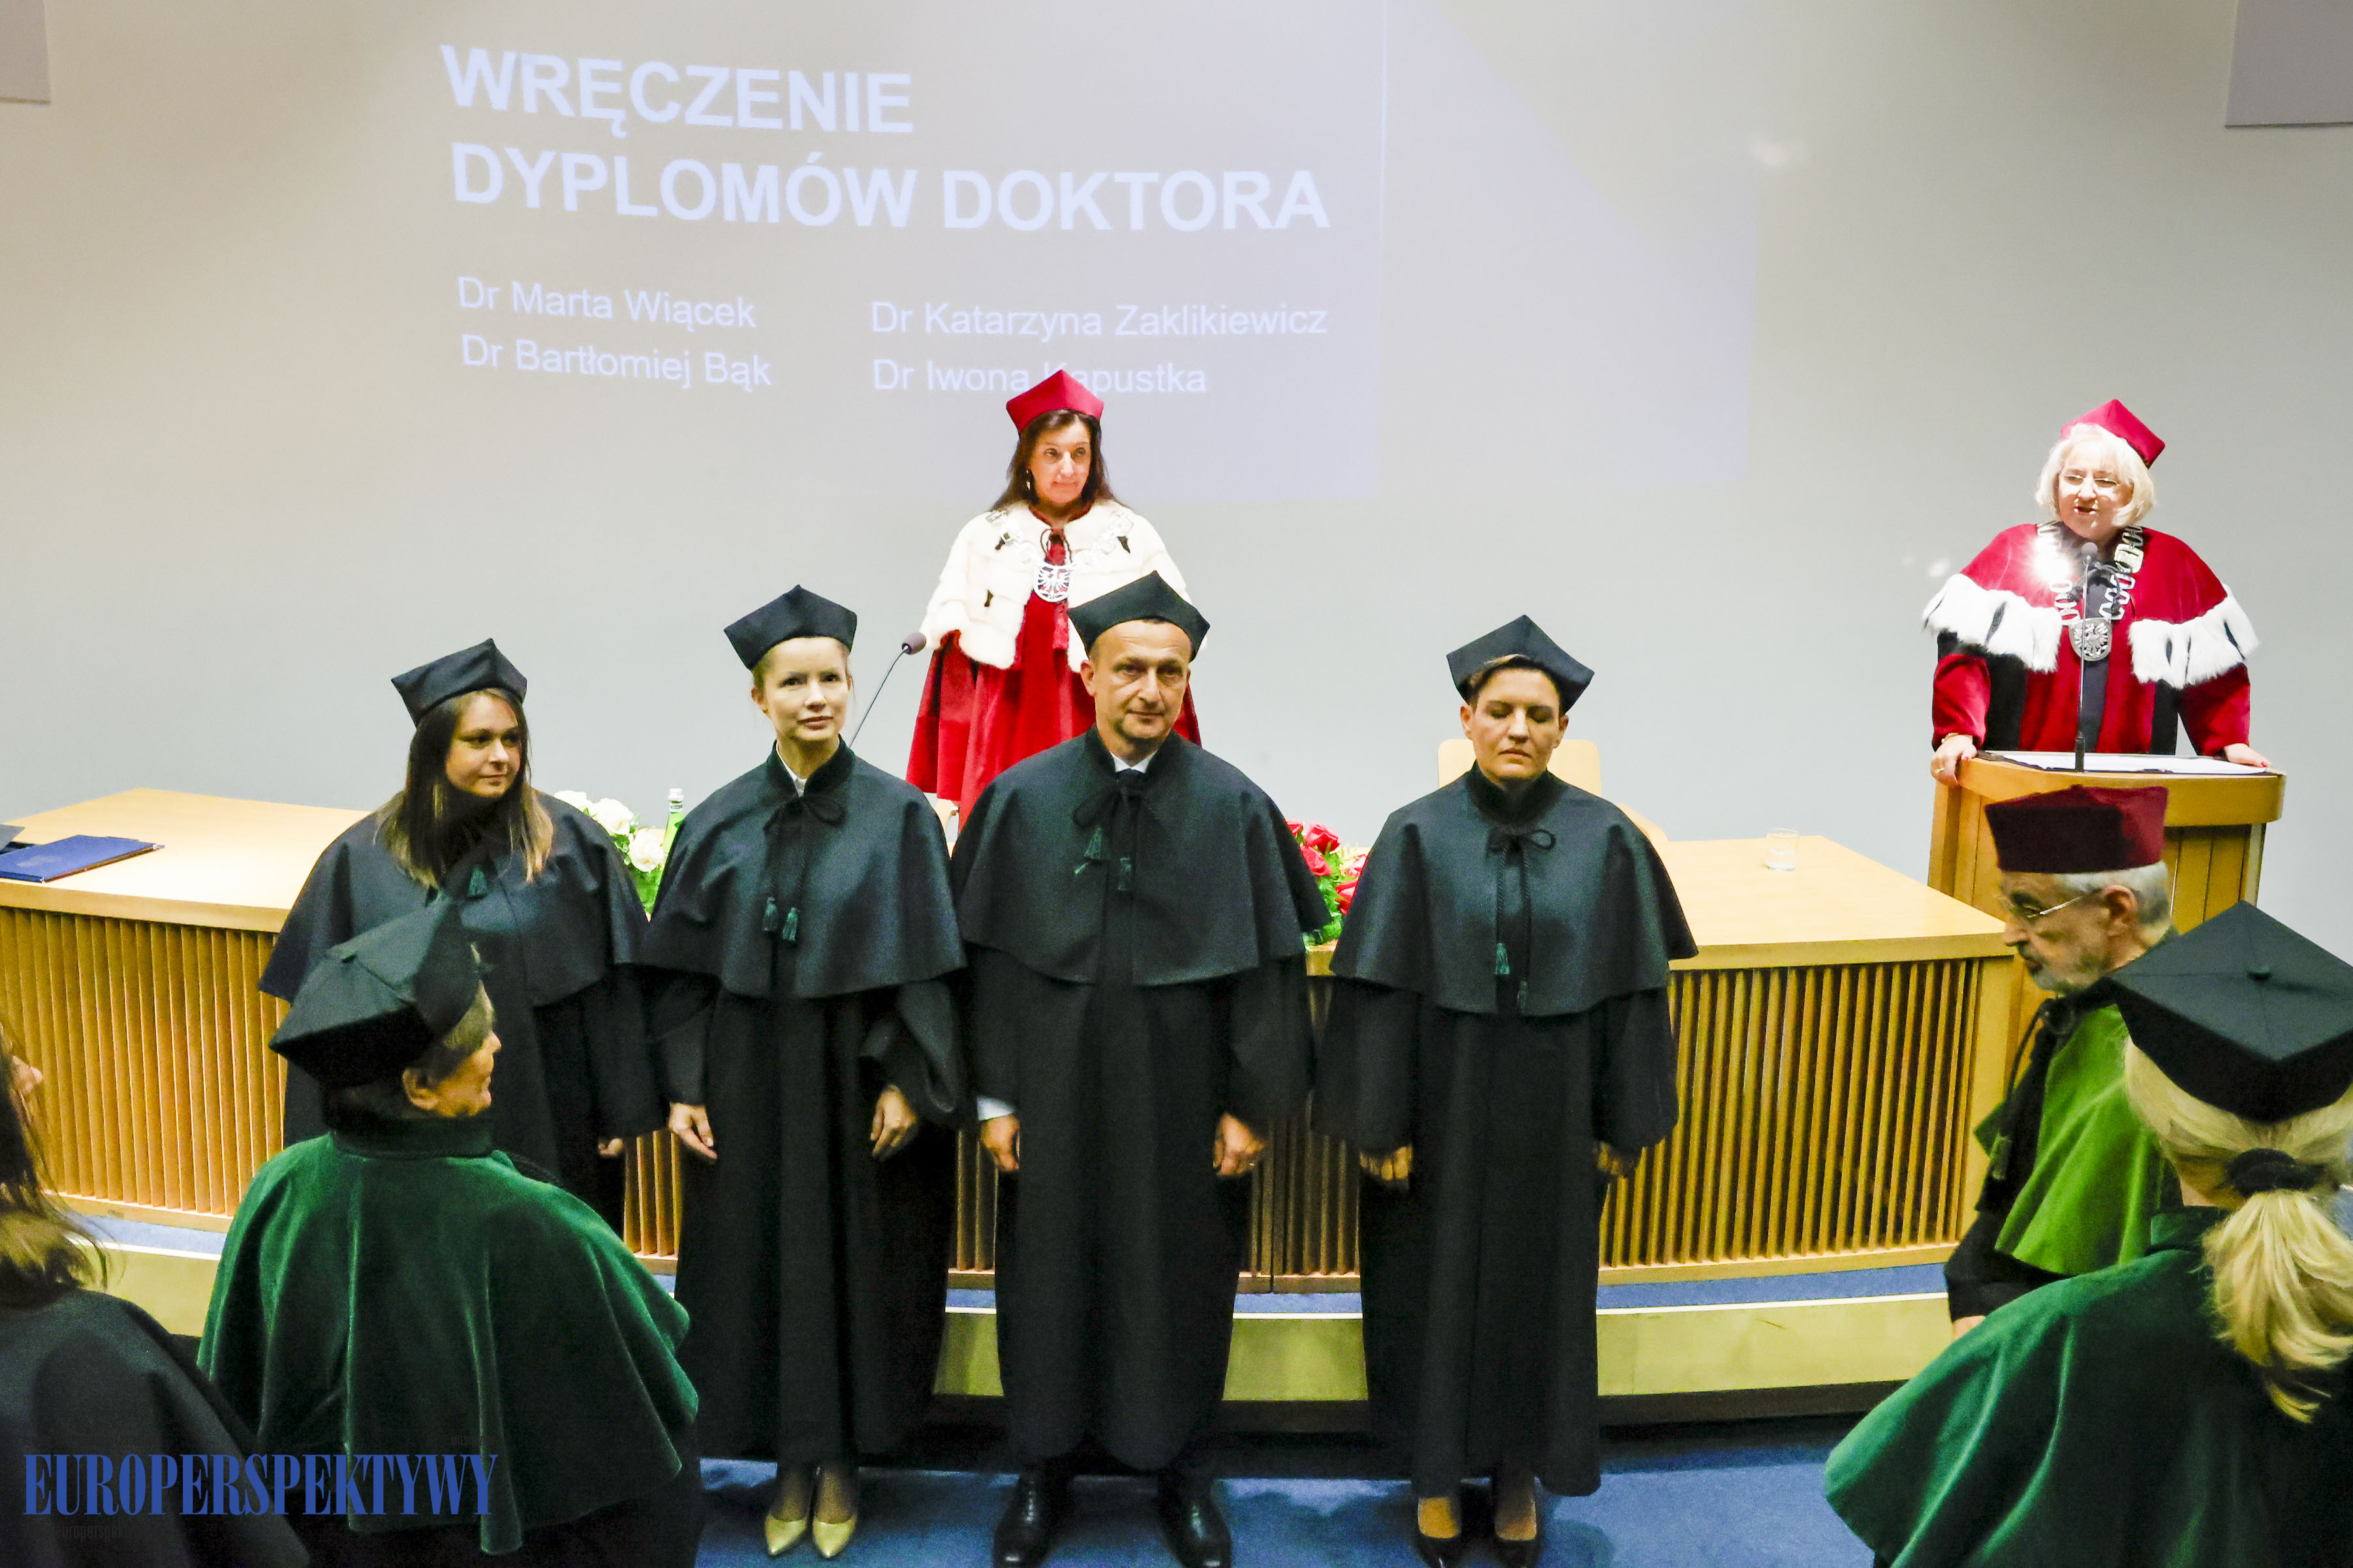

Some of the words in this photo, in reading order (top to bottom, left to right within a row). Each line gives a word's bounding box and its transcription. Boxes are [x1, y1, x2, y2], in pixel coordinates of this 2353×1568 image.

[440, 44, 914, 139] WRĘCZENIE
[452, 142, 918, 228] DYPLOMÓW
[944, 170, 1331, 232] DOKTORA
[459, 277, 500, 311] Dr
[512, 281, 614, 320] Marta
[625, 290, 757, 333] Wiącek
[873, 301, 914, 333] Dr
[926, 303, 1102, 343] Katarzyna
[1115, 304, 1329, 337] Zaklikiewicz
[462, 334, 504, 368] Dr
[516, 339, 692, 390] Bartłomiej
[705, 352, 773, 393] Bąk
[874, 360, 915, 391] Dr
[927, 361, 1031, 393] Iwona
